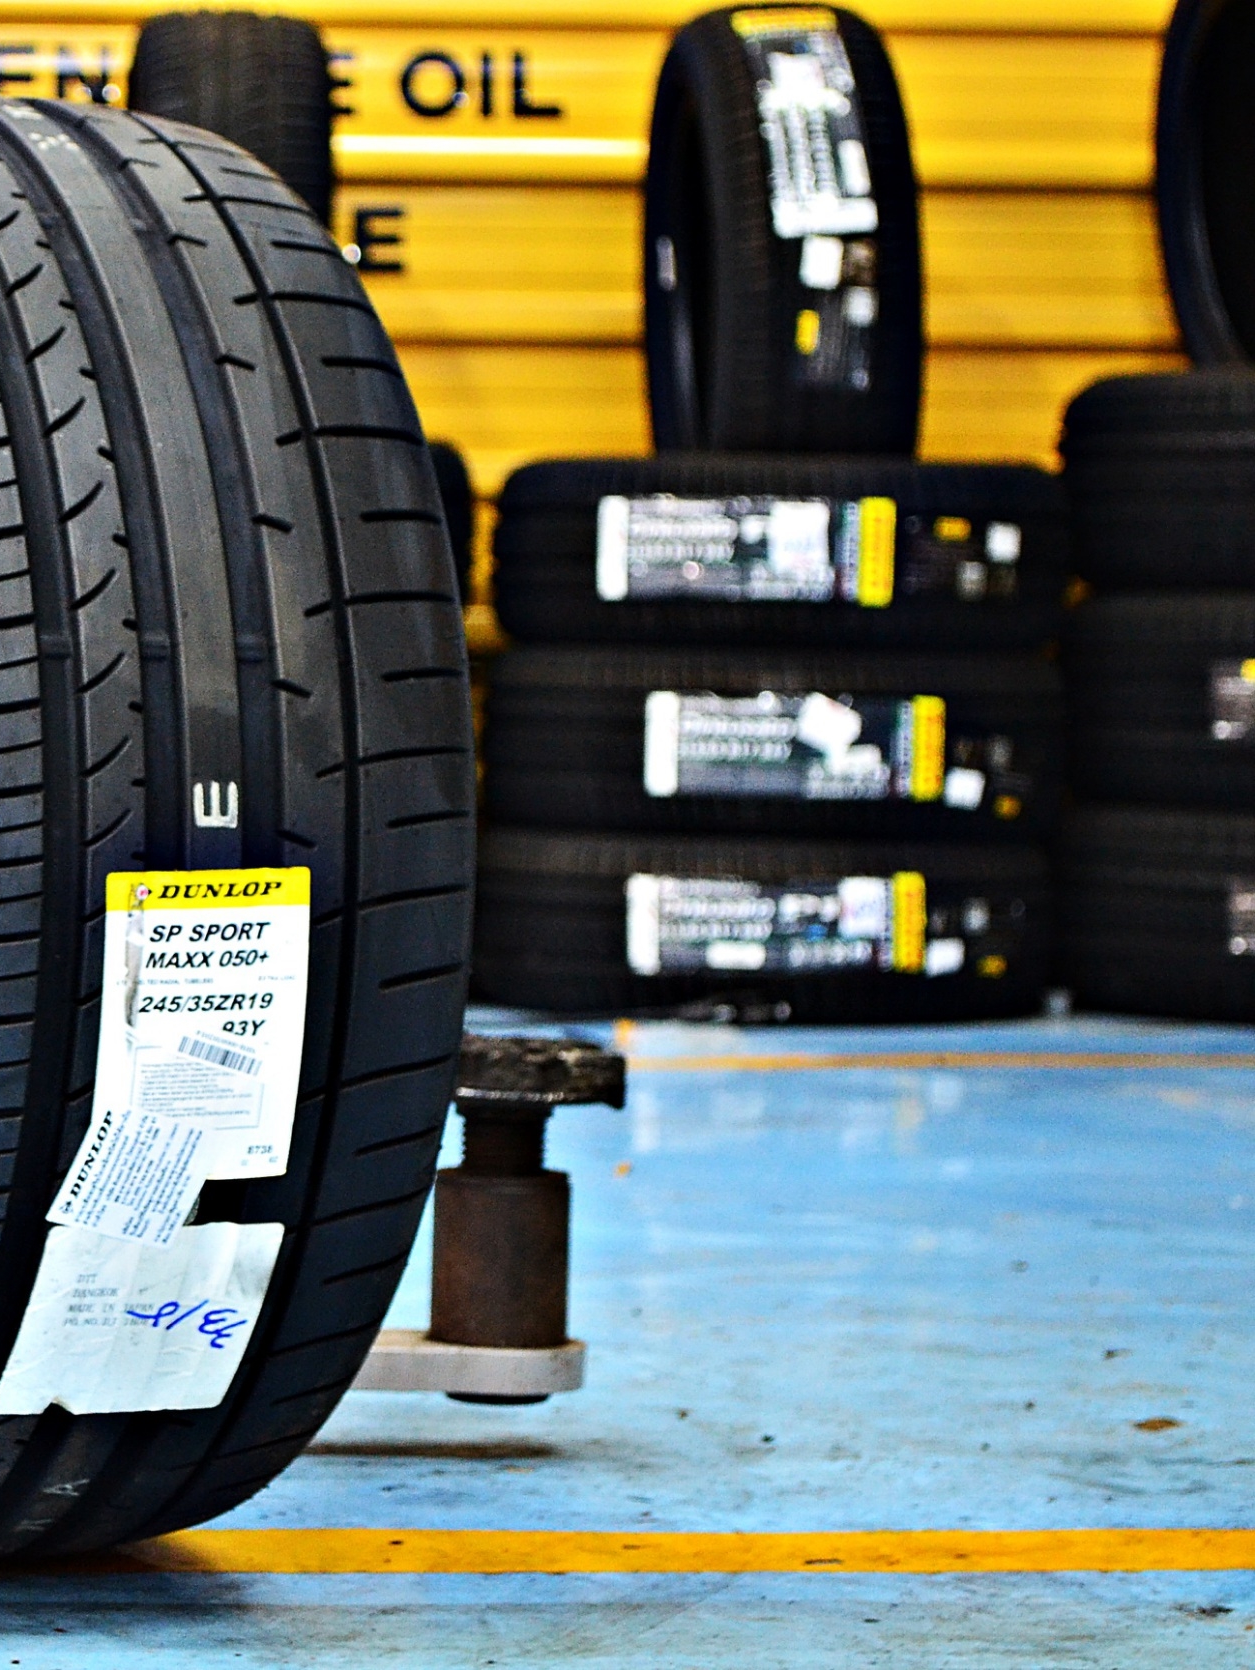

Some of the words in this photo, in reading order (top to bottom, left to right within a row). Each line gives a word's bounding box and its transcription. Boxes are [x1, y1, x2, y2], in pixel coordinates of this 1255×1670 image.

[400, 50, 563, 118] OIL
[158, 881, 283, 900] DUNLOP
[149, 924, 183, 943] SP
[188, 921, 271, 942] SPORT
[145, 951, 215, 970] MAXX
[219, 949, 270, 968] 050+
[138, 992, 274, 1013] 245/35ZR19
[222, 1019, 266, 1037] 93Y
[70, 1110, 113, 1200] DUNLOP
